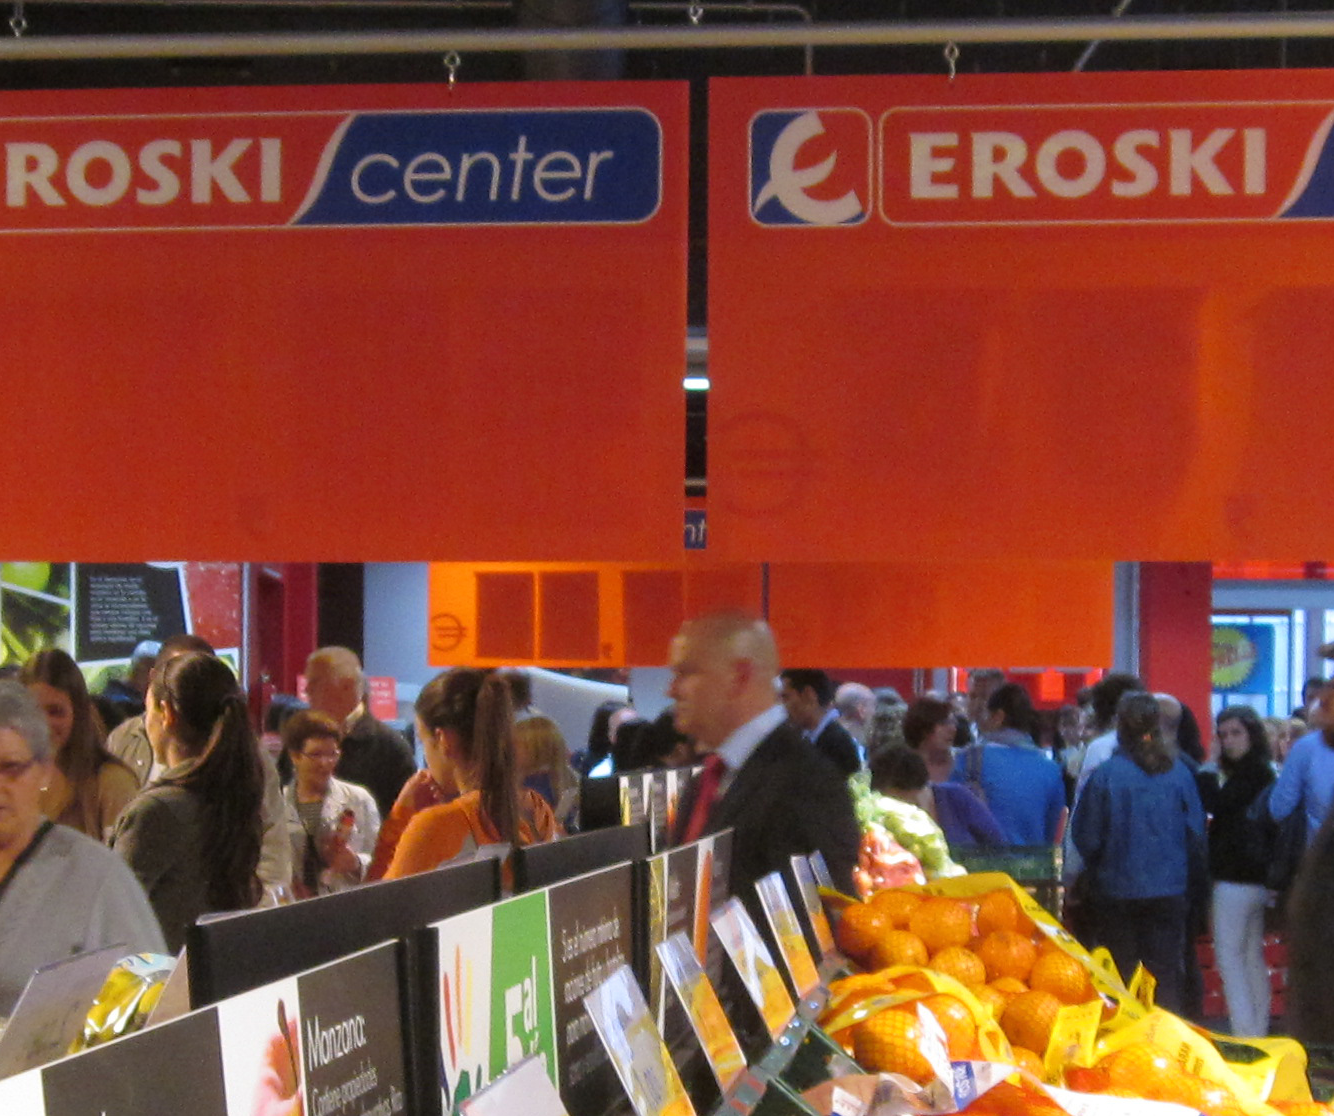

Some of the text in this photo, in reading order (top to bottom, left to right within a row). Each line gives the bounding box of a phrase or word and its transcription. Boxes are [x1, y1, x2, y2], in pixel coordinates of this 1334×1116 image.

[350, 135, 613, 203] center
[909, 128, 1266, 200] EROSKI
[523, 955, 538, 1034] al
